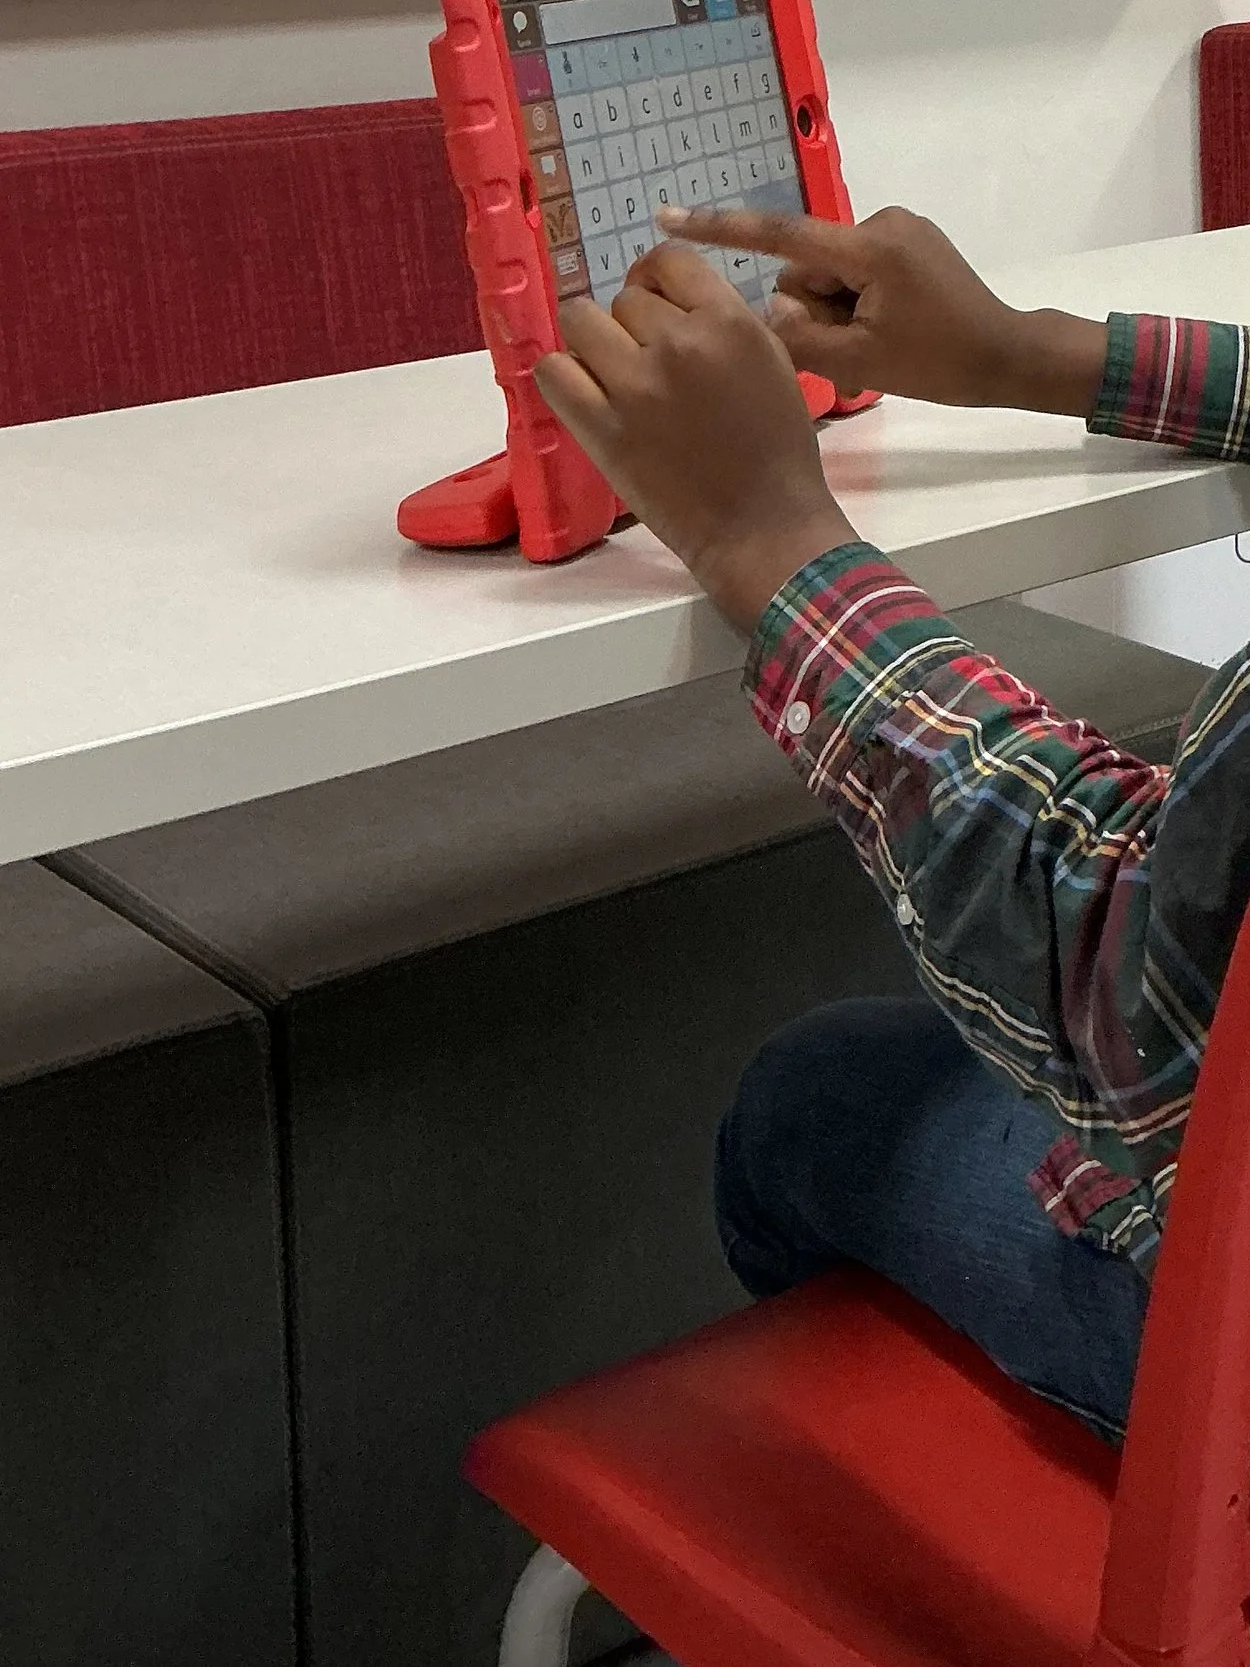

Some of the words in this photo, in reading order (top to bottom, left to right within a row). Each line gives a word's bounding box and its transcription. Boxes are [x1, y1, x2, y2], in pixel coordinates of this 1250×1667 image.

[572, 112, 584, 130] a
[606, 99, 618, 122] b
[642, 97, 651, 115] c
[672, 84, 683, 108] d
[703, 85, 713, 101] e
[733, 72, 740, 94] f
[761, 73, 771, 94] g
[581, 157, 593, 177] h
[617, 145, 625, 167] i
[650, 138, 659, 166] j
[680, 130, 692, 152] k
[738, 120, 752, 137] m
[768, 114, 778, 130] n
[591, 206, 602, 225] o
[625, 197, 636, 221] p
[691, 178, 698, 196] r
[720, 170, 729, 187] s
[777, 155, 786, 171] u
[599, 253, 609, 271] v
